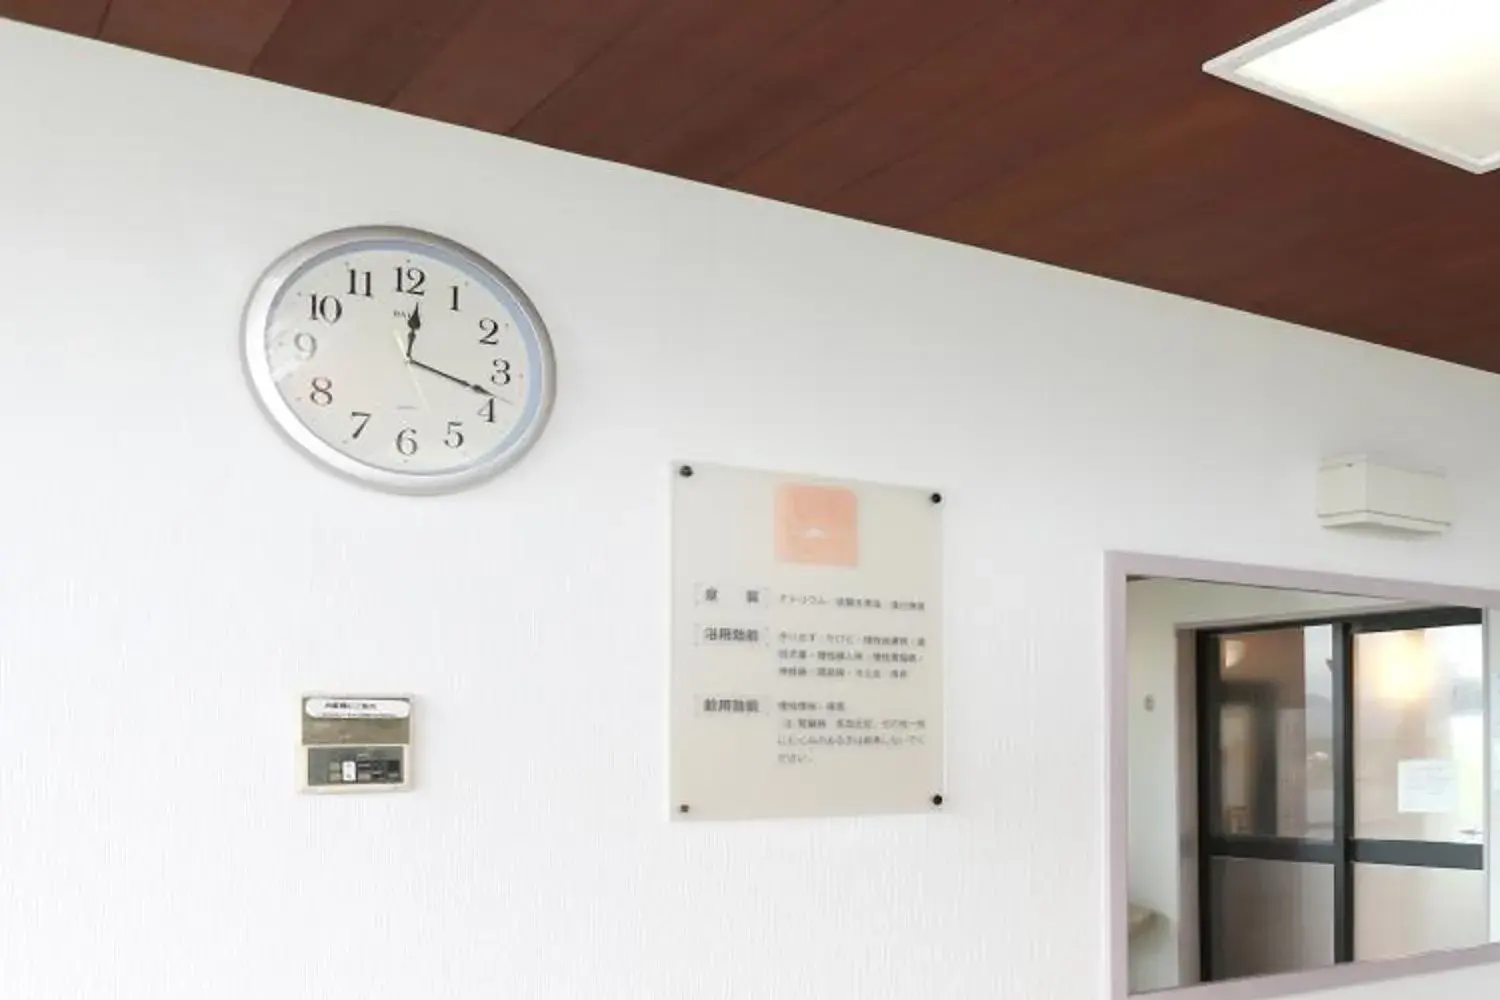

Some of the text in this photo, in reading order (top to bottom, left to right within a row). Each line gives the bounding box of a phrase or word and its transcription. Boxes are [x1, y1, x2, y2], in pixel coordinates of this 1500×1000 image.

[348, 269, 373, 297] 11
[394, 267, 426, 296] 12
[310, 294, 342, 323] 10
[450, 286, 461, 310] 1
[479, 318, 498, 345] 2
[295, 333, 317, 359] 9
[491, 359, 510, 385] 3
[310, 377, 333, 406] 8
[478, 398, 495, 422] 4
[351, 411, 371, 438] 7
[445, 422, 463, 448] 5
[396, 429, 417, 456] 6
